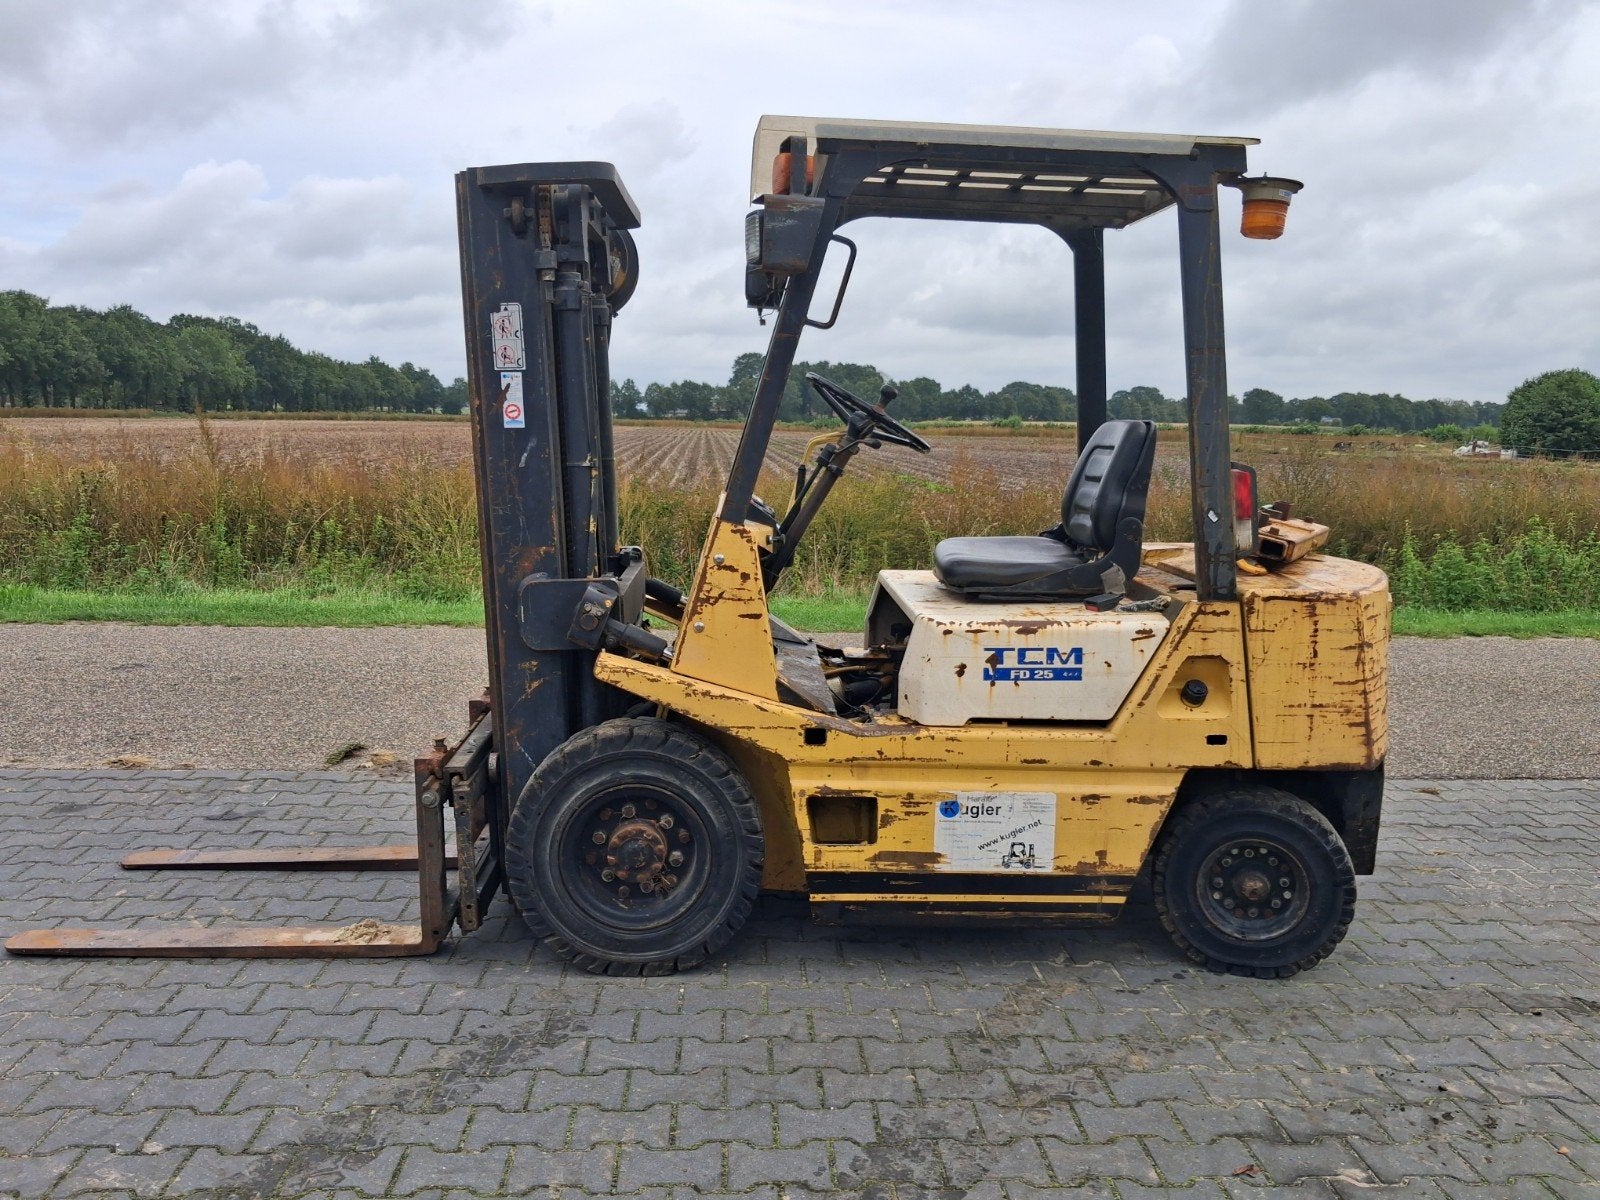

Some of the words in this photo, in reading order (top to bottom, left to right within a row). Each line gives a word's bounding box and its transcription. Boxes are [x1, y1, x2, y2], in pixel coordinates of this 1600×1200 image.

[984, 648, 1083, 664] TCM
[1010, 669, 1031, 679] FD
[1034, 669, 1054, 679] 25
[977, 819, 1042, 851] www.kugler.net
